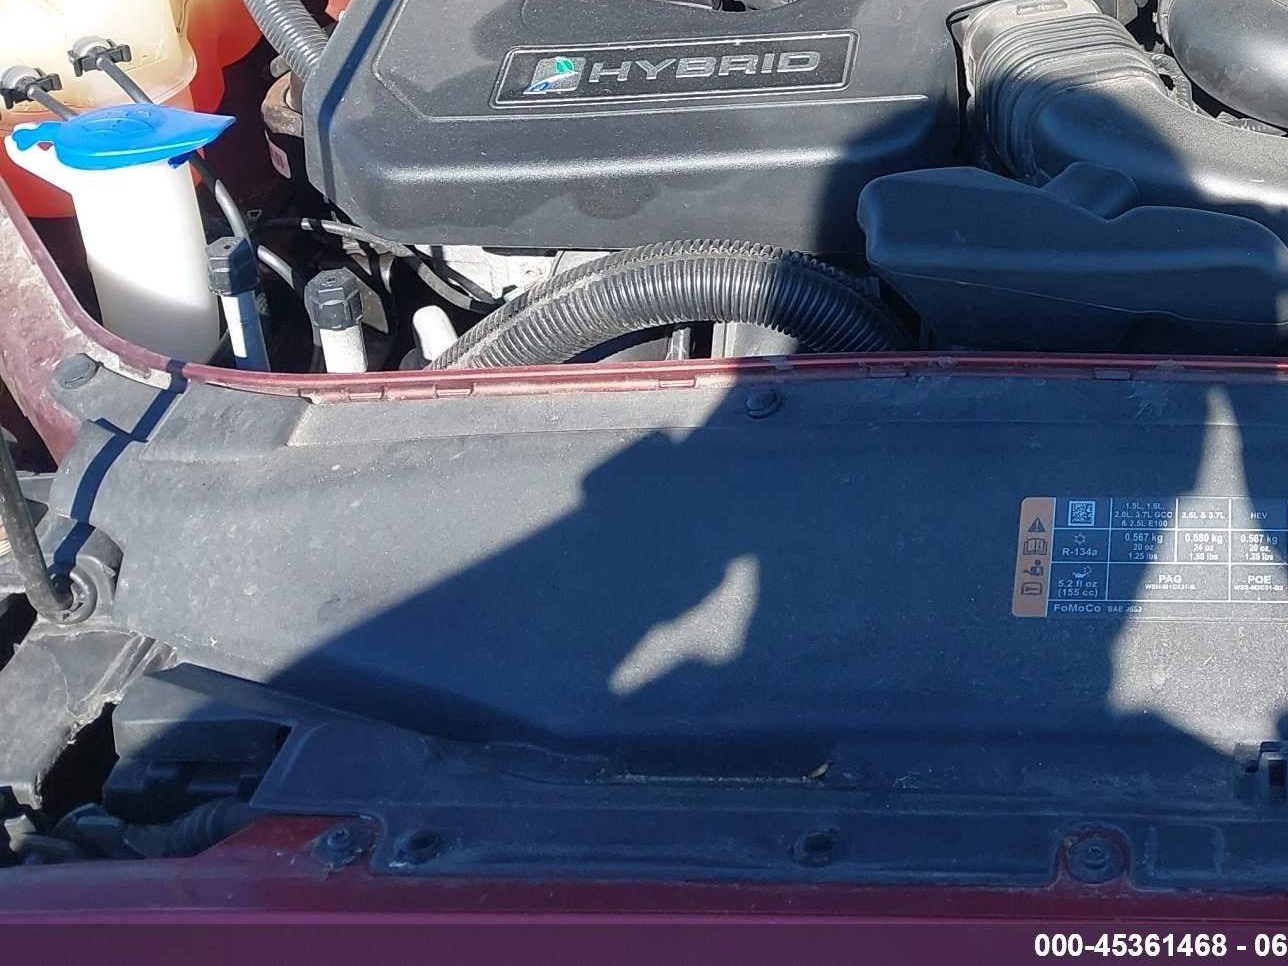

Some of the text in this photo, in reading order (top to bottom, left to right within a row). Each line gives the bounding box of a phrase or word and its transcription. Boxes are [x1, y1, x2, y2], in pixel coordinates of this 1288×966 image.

[588, 50, 821, 83] HYBRID
[1250, 512, 1268, 520] HEV
[1151, 533, 1164, 544] kg
[1211, 532, 1224, 545] kg
[1240, 533, 1279, 545] 0.567 kg
[1062, 547, 1098, 557] R-134a
[1058, 579, 1074, 588] 5.2
[1158, 574, 1183, 584] PAG
[1247, 574, 1272, 584] POE
[1057, 587, 1098, 597] (155 cc)
[1053, 604, 1101, 613] FoMoCo
[1107, 604, 1123, 613] SAE
